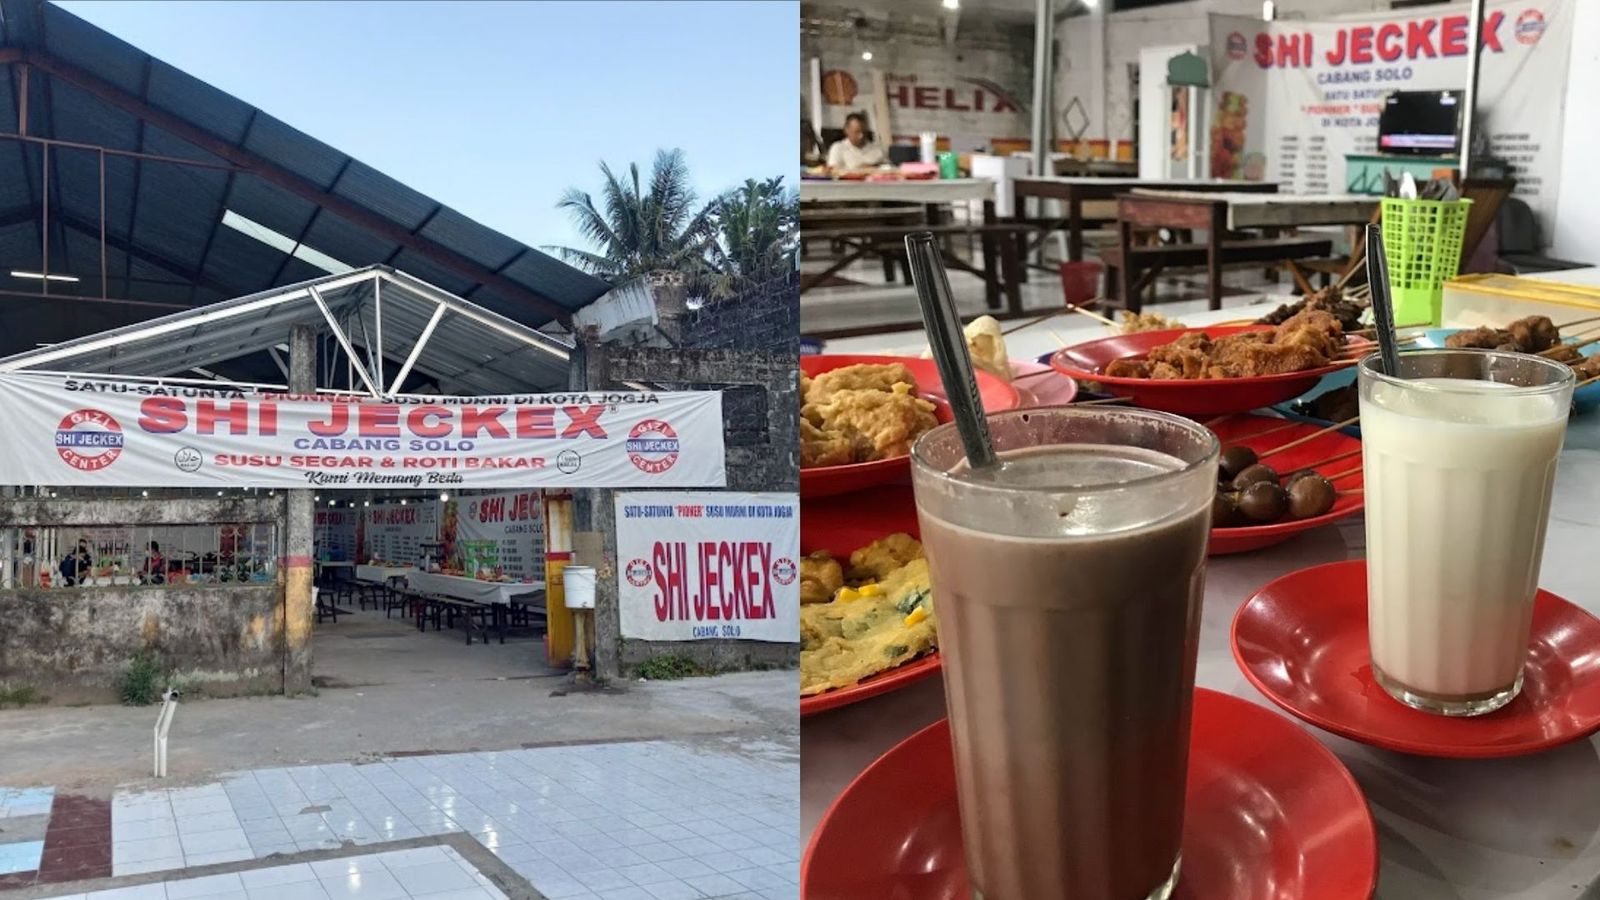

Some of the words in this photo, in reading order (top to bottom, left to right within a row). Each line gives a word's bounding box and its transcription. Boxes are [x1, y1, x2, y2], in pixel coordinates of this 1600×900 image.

[1254, 32, 1313, 69] SHI
[1326, 10, 1505, 66] JECKEX
[1318, 70, 1370, 84] CABANG
[1375, 67, 1413, 82] SOLO
[887, 86, 1017, 113] HELIX
[64, 380, 246, 399] SATU-SATUNYA
[381, 395, 436, 405] SUSU
[540, 393, 592, 405] KOTA
[598, 393, 660, 404] JOGJA
[70, 412, 110, 427] GIZI
[137, 397, 278, 437] SHI
[308, 403, 608, 440] JECKEX
[637, 421, 668, 434] GIZI
[56, 434, 75, 445] SHI
[79, 434, 123, 446] JECKEX
[294, 438, 401, 451] CABANG
[410, 439, 475, 452] SOLO
[627, 440, 643, 451] SHI
[644, 440, 678, 451] JECKEX
[62, 449, 118, 469] CENTER
[214, 454, 282, 467] SUSU
[290, 456, 373, 468] SEGAR
[380, 457, 395, 468] &
[403, 457, 457, 468] ROTI
[465, 457, 546, 469] BAKAR
[632, 453, 677, 472] CENTER
[304, 471, 349, 485] Kami
[354, 471, 422, 487] Memang
[426, 471, 464, 484] Beda
[480, 496, 506, 523] SHI
[624, 505, 674, 518] SATU-SATUNYA
[705, 505, 724, 518] SUSU
[653, 540, 690, 623] SHI
[693, 540, 777, 622] JECKEX
[692, 625, 719, 638] CABANG
[721, 625, 741, 637] SOLO
